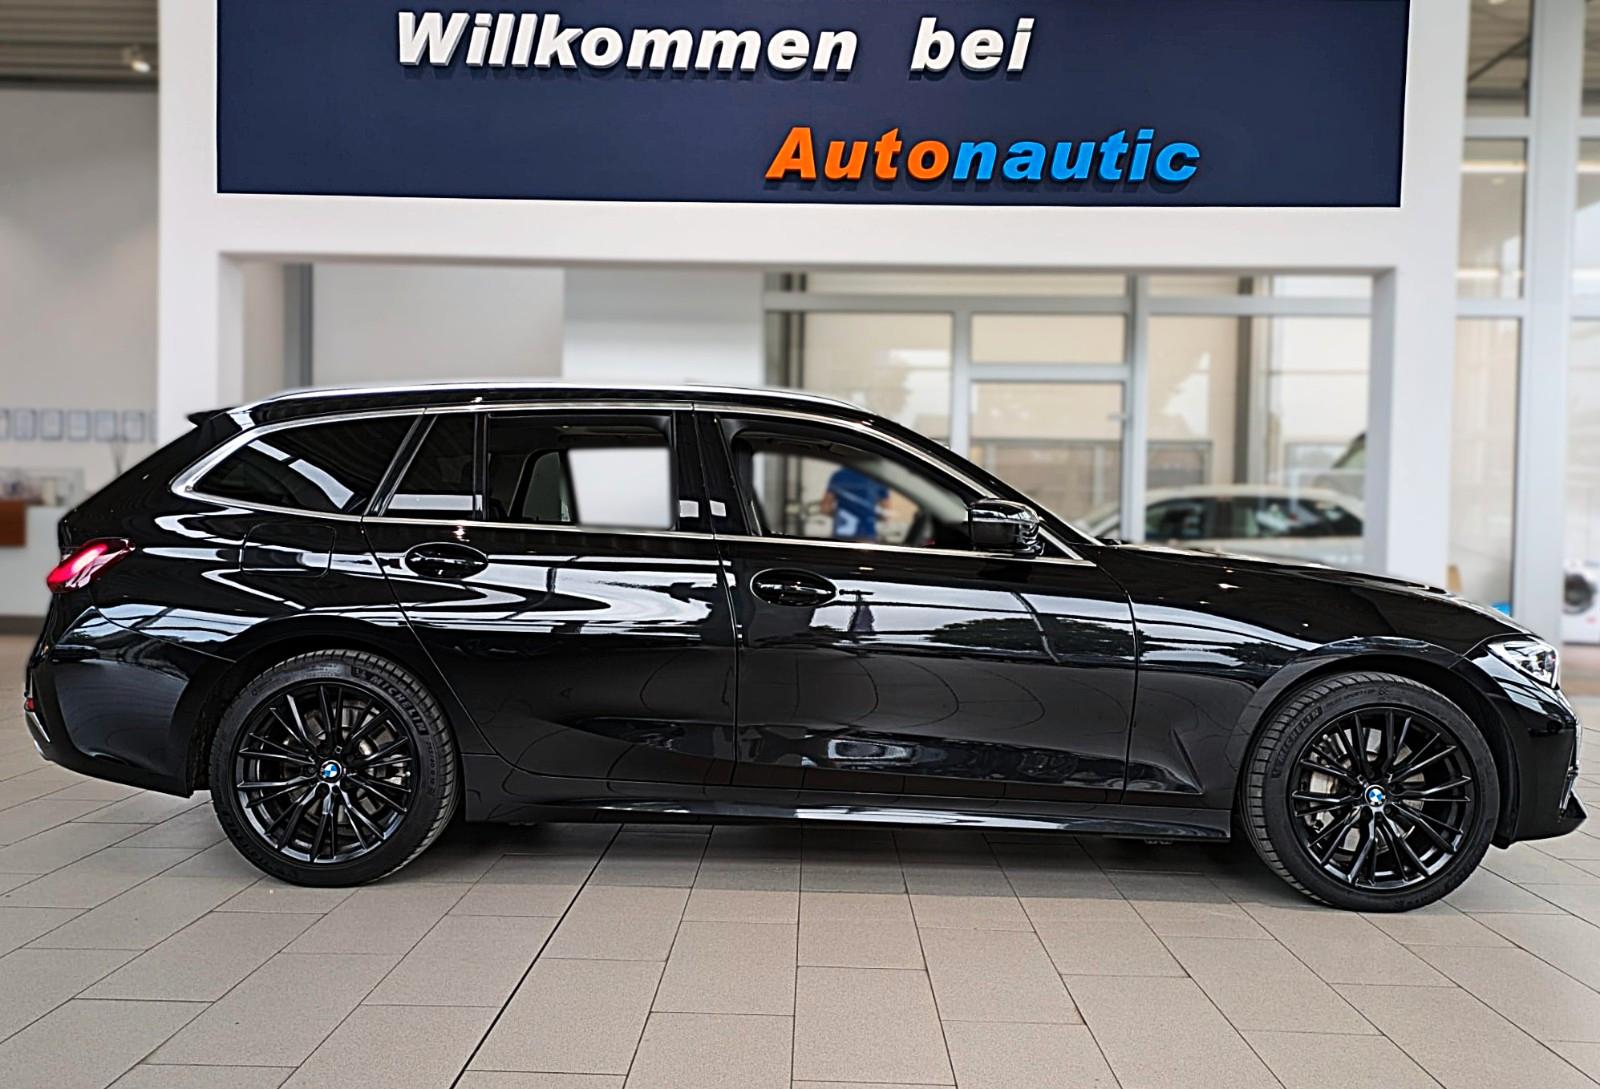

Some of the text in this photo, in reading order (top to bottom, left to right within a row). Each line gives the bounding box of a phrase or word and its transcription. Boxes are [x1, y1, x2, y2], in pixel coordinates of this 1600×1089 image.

[398, 11, 1035, 72] Willkommen bei
[764, 126, 1201, 183] Autonautic
[370, 674, 426, 733] MICHELIN
